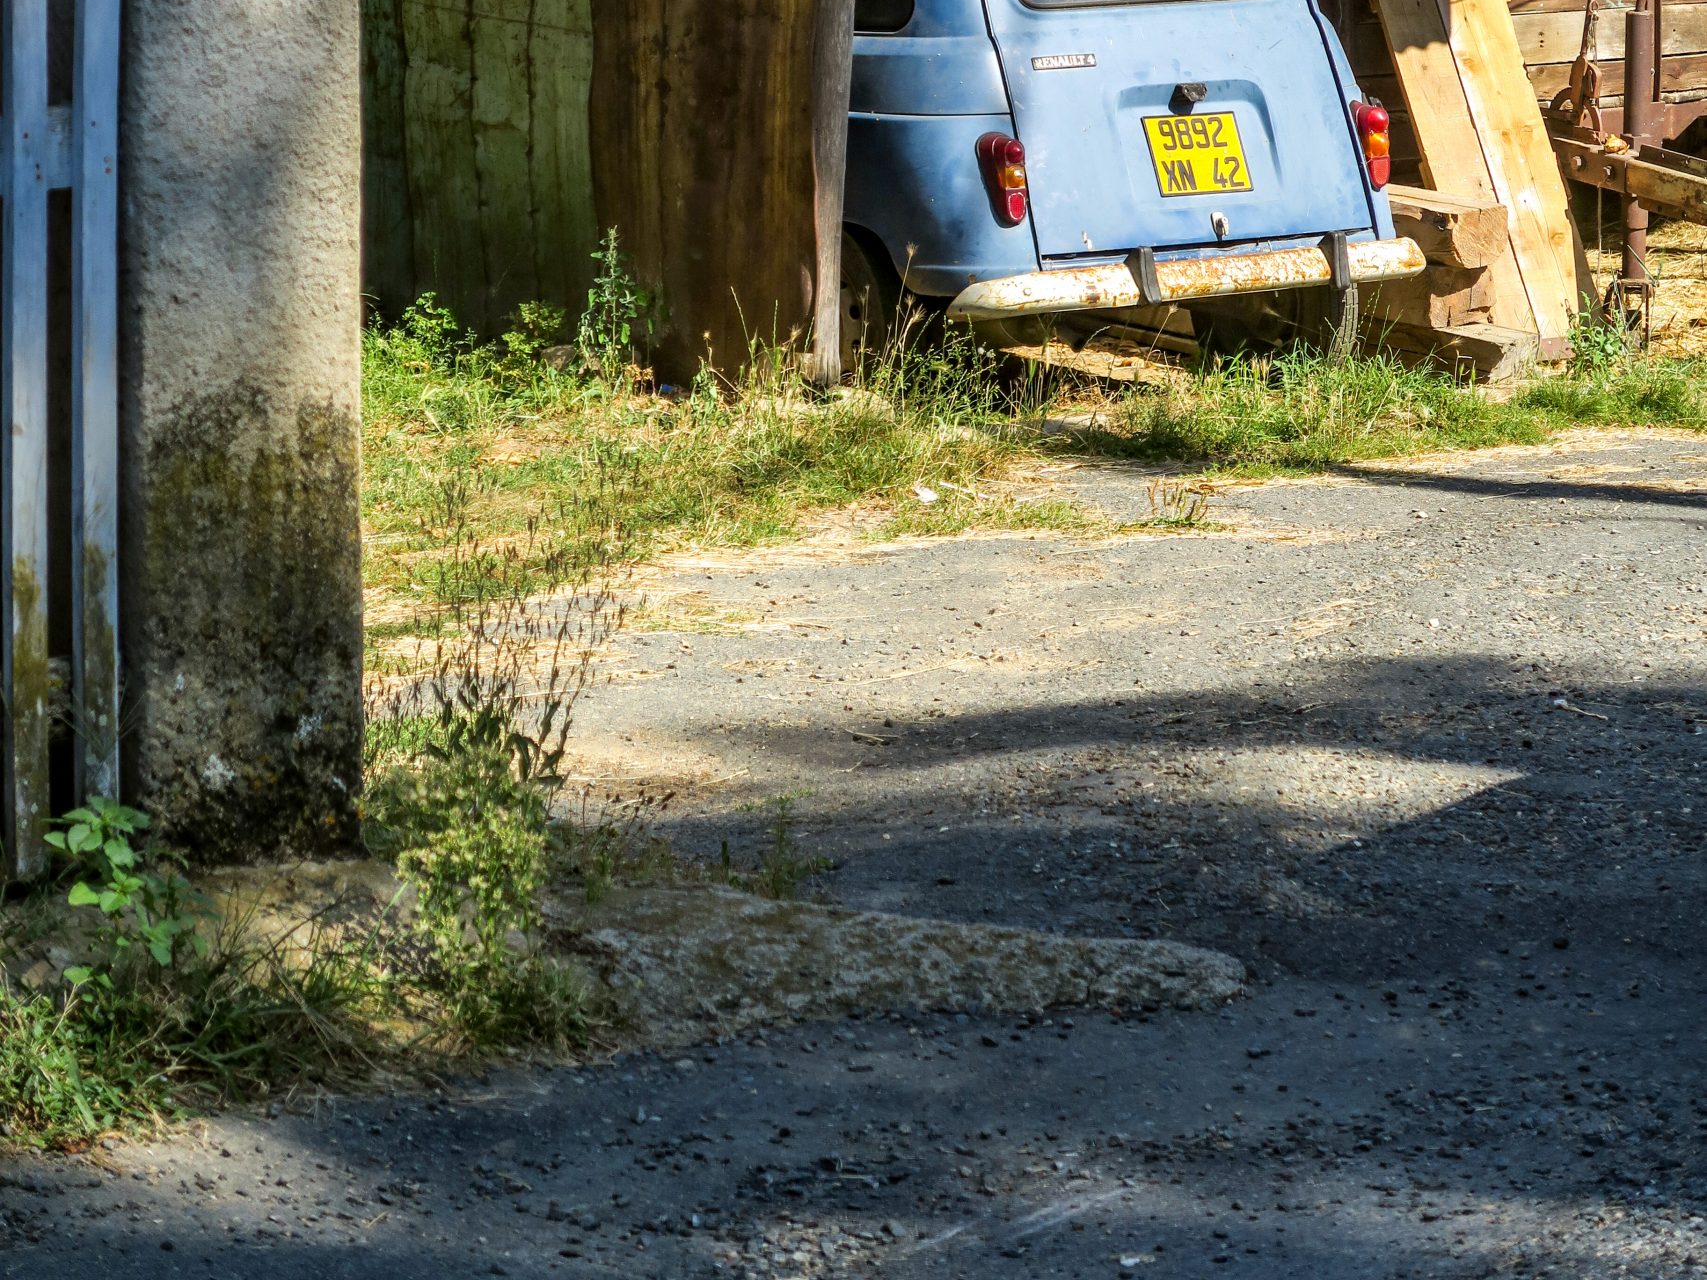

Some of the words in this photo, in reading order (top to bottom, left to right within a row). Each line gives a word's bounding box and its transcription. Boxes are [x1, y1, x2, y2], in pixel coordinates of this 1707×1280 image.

[1033, 55, 1085, 69] RENAULT
[1086, 55, 1096, 65] 4
[1158, 116, 1228, 150] 9892
[1161, 159, 1198, 191] XN
[1213, 156, 1245, 188] 42
